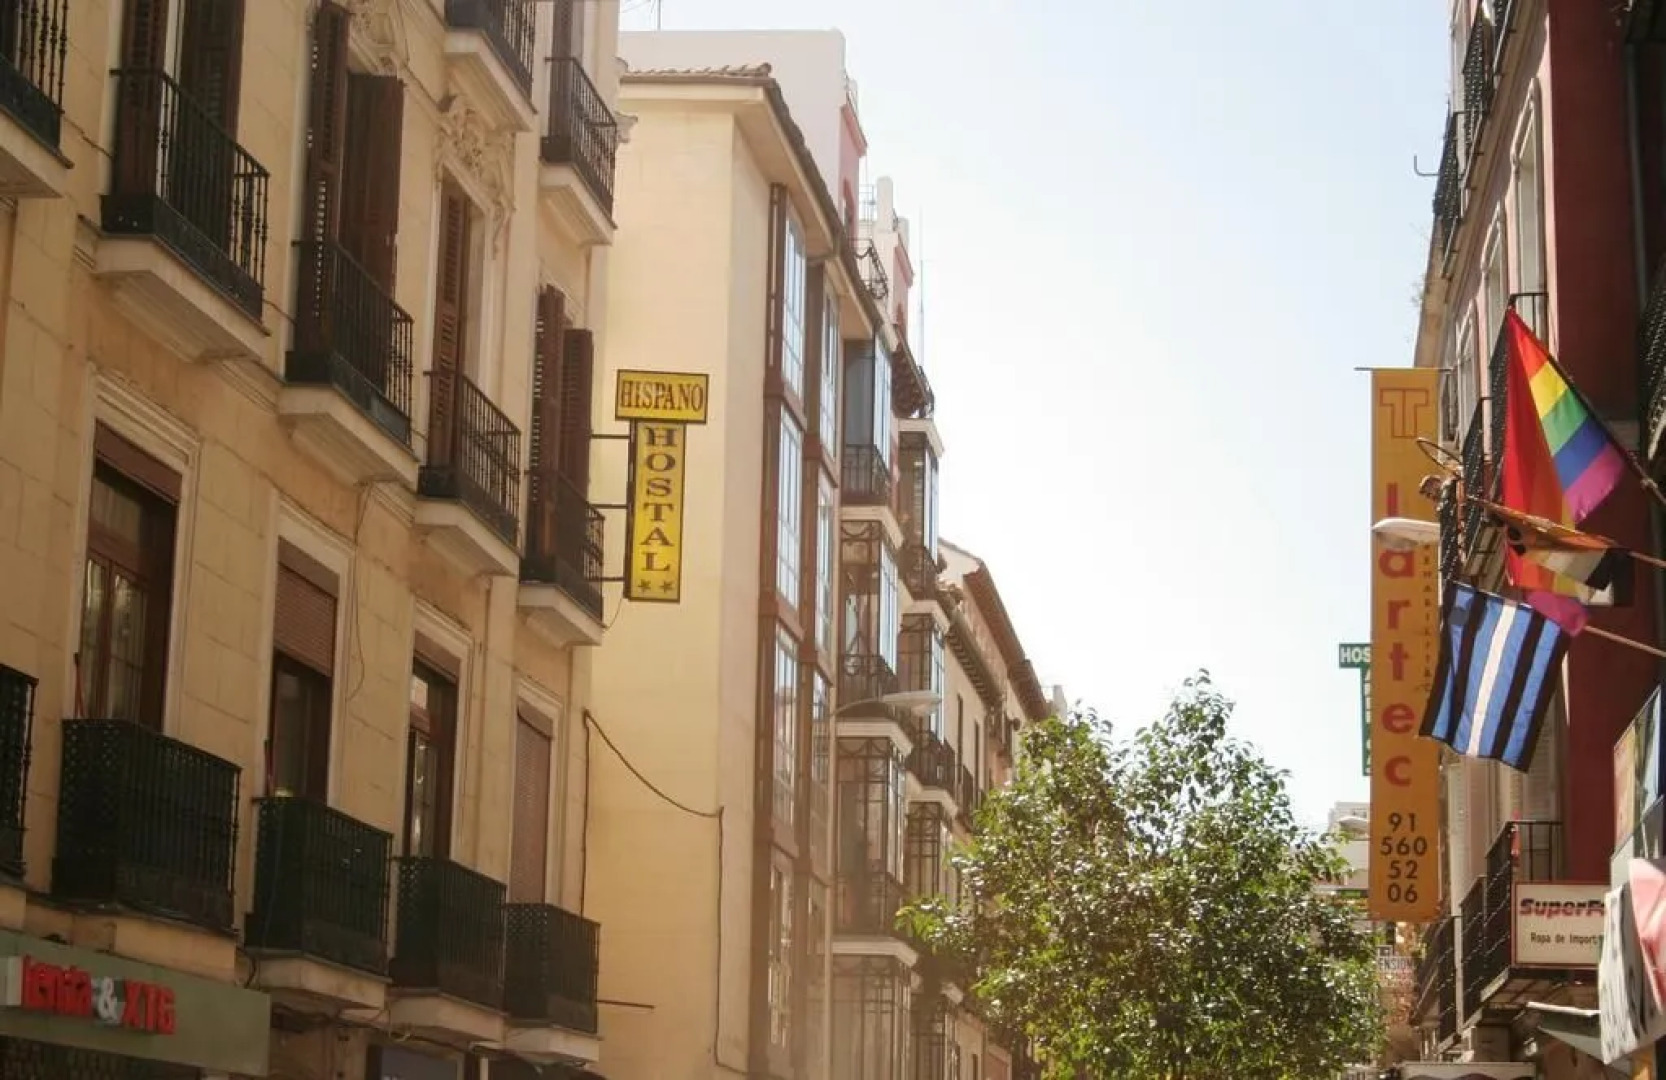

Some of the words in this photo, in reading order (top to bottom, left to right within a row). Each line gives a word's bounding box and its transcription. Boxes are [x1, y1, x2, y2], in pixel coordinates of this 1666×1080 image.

[620, 380, 704, 413] HISPANO
[639, 427, 678, 572] HOSTAL
[1387, 812, 1416, 832] 91
[1380, 837, 1428, 856] 560
[1387, 860, 1418, 880] 52
[1387, 884, 1418, 904] 06
